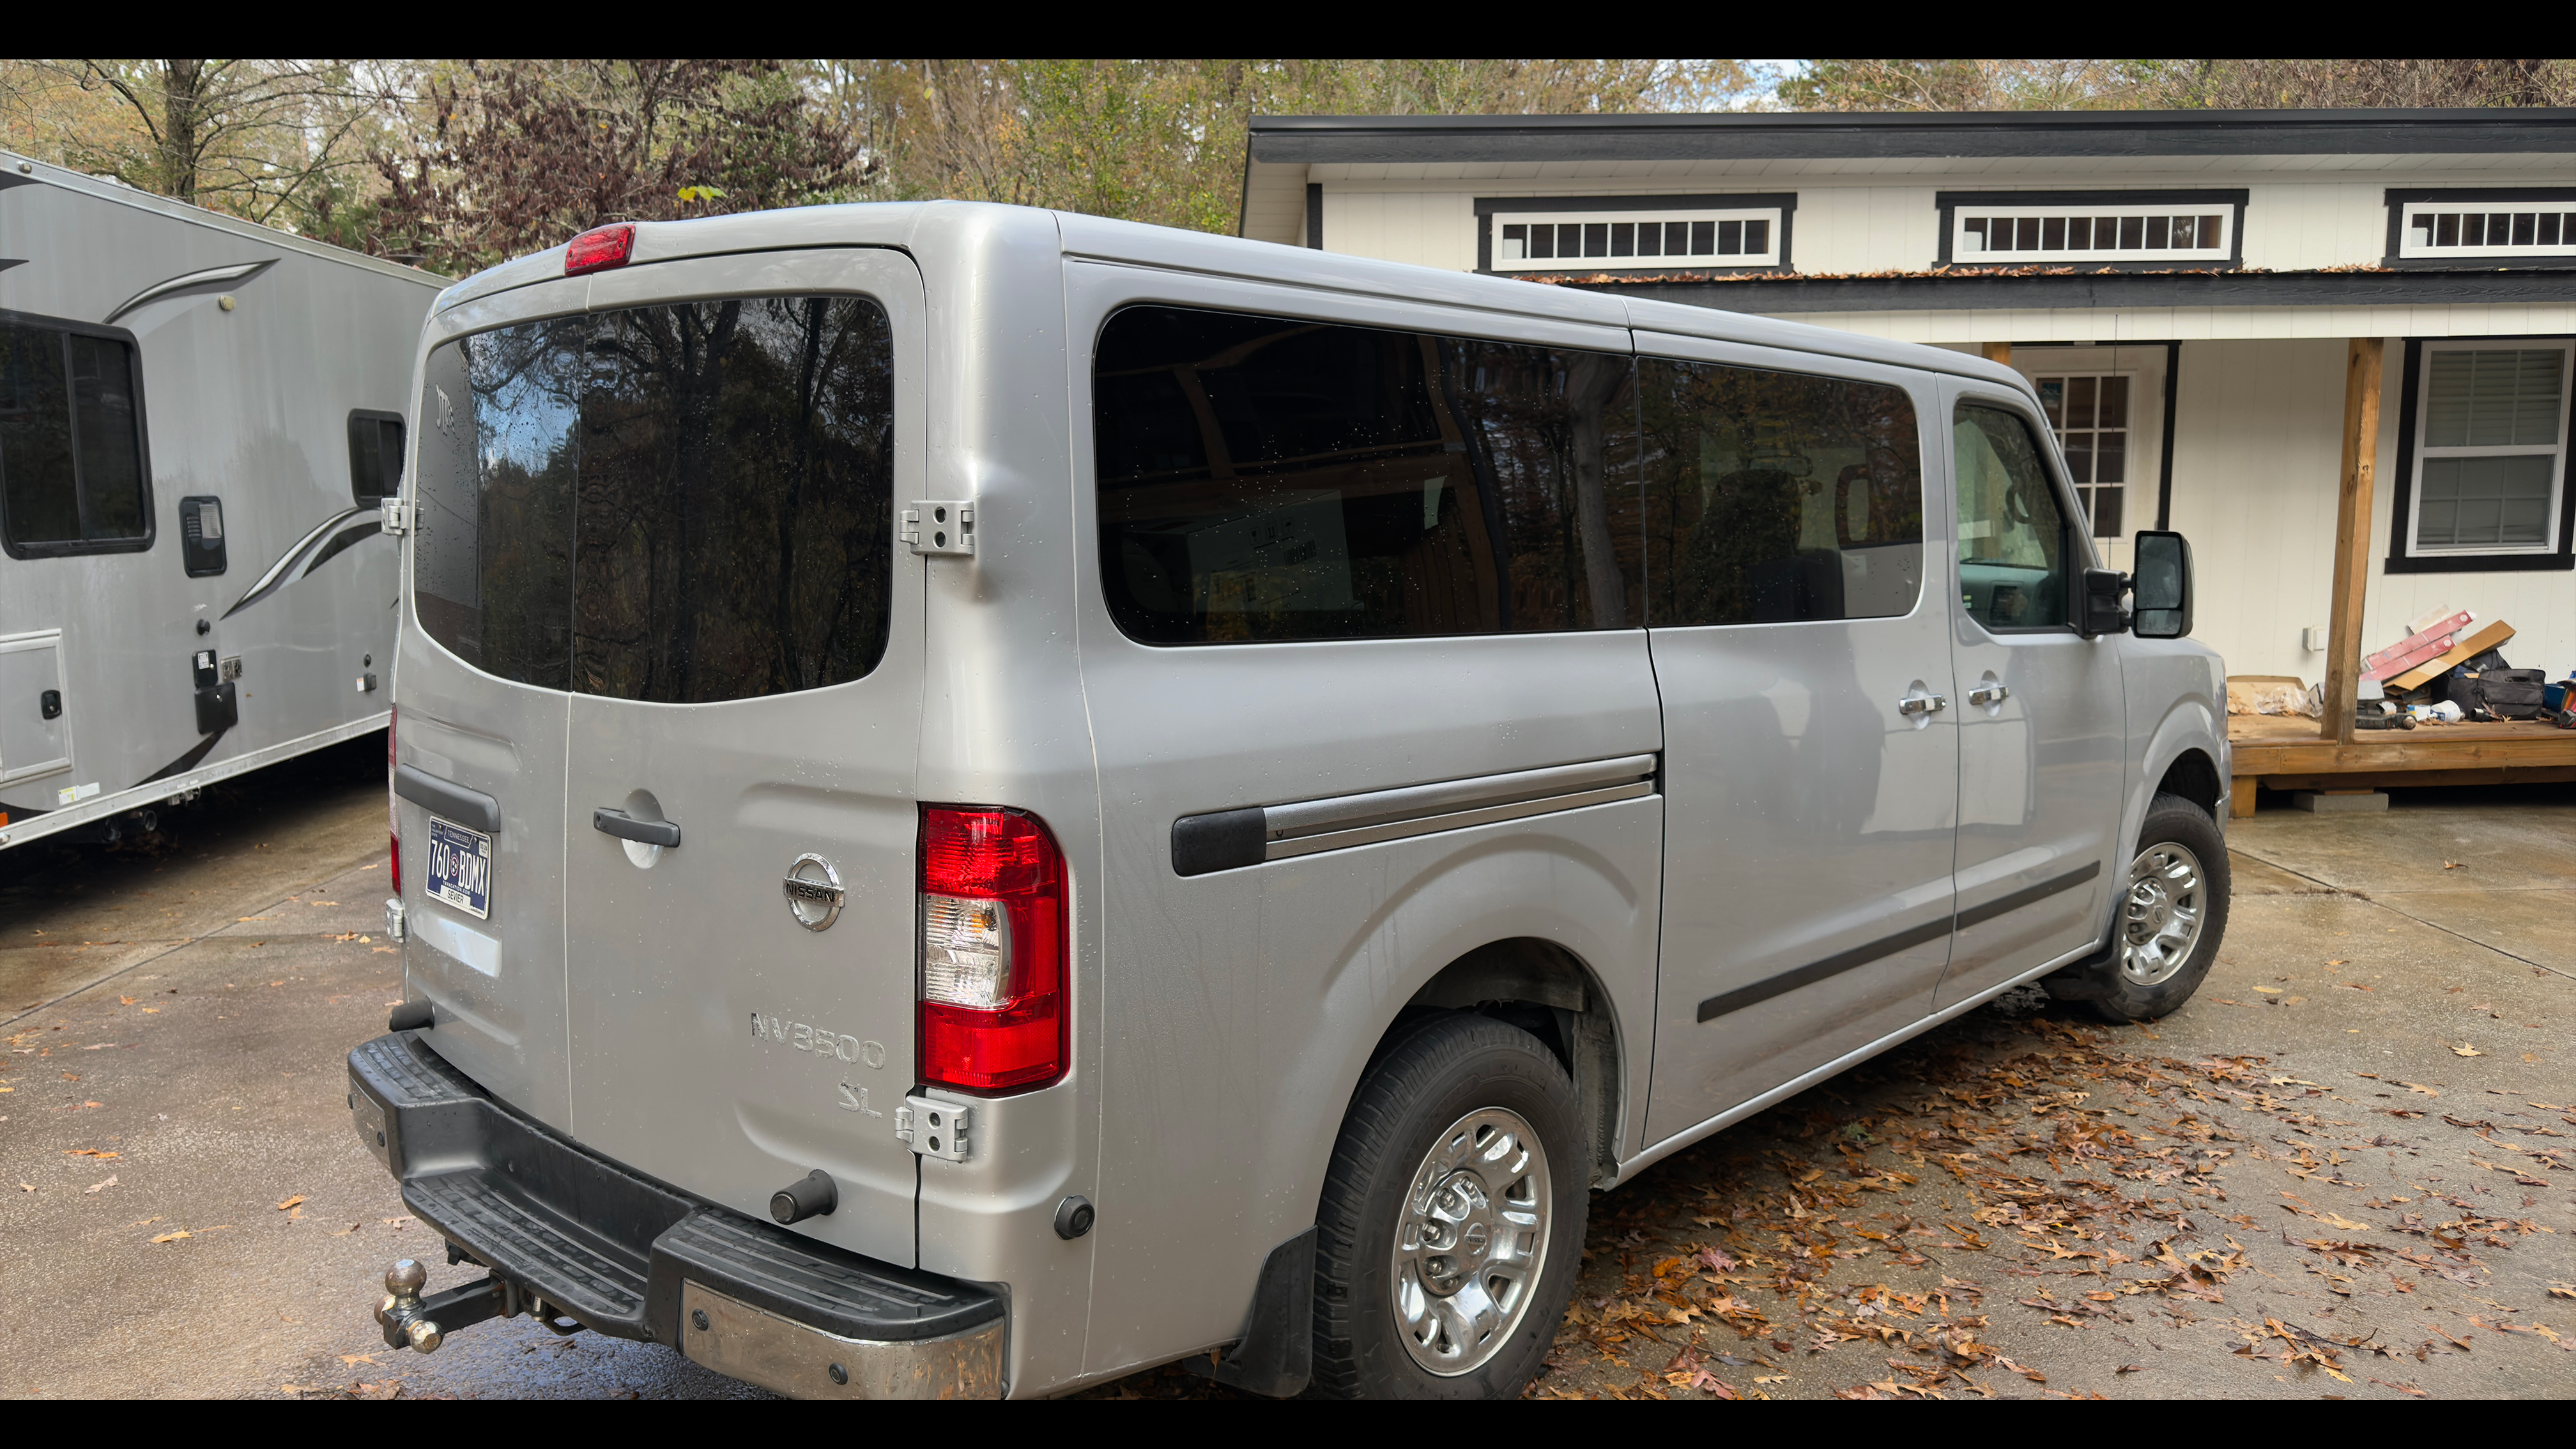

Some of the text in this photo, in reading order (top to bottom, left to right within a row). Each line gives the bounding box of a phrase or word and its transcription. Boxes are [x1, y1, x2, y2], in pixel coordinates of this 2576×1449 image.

[448, 830, 470, 844] TENNESSEE
[431, 839, 486, 896] 760 BDMX
[447, 889, 464, 904] SEVIER
[786, 883, 834, 903] NISSAN
[751, 1012, 885, 1070] NV3500
[838, 1082, 882, 1119] SL
